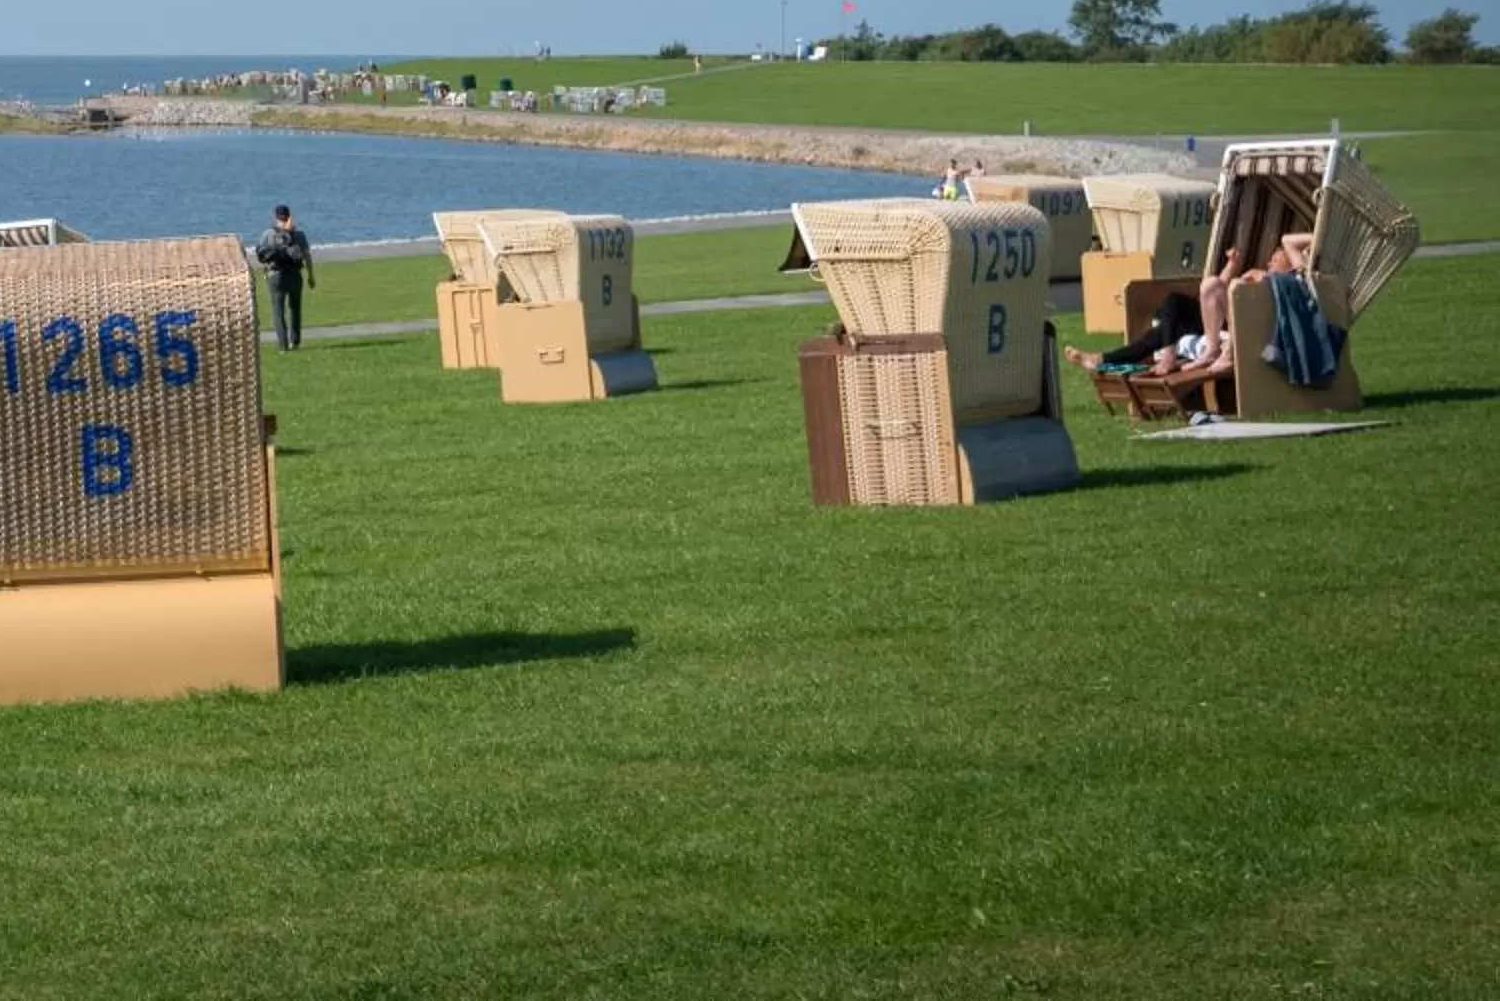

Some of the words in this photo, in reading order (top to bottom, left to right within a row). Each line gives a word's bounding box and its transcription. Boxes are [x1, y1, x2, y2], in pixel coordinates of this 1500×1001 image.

[587, 225, 625, 261] 1132
[970, 227, 1037, 287] 1250
[601, 274, 613, 308] B
[987, 303, 1007, 355] B
[81, 422, 133, 496] B
